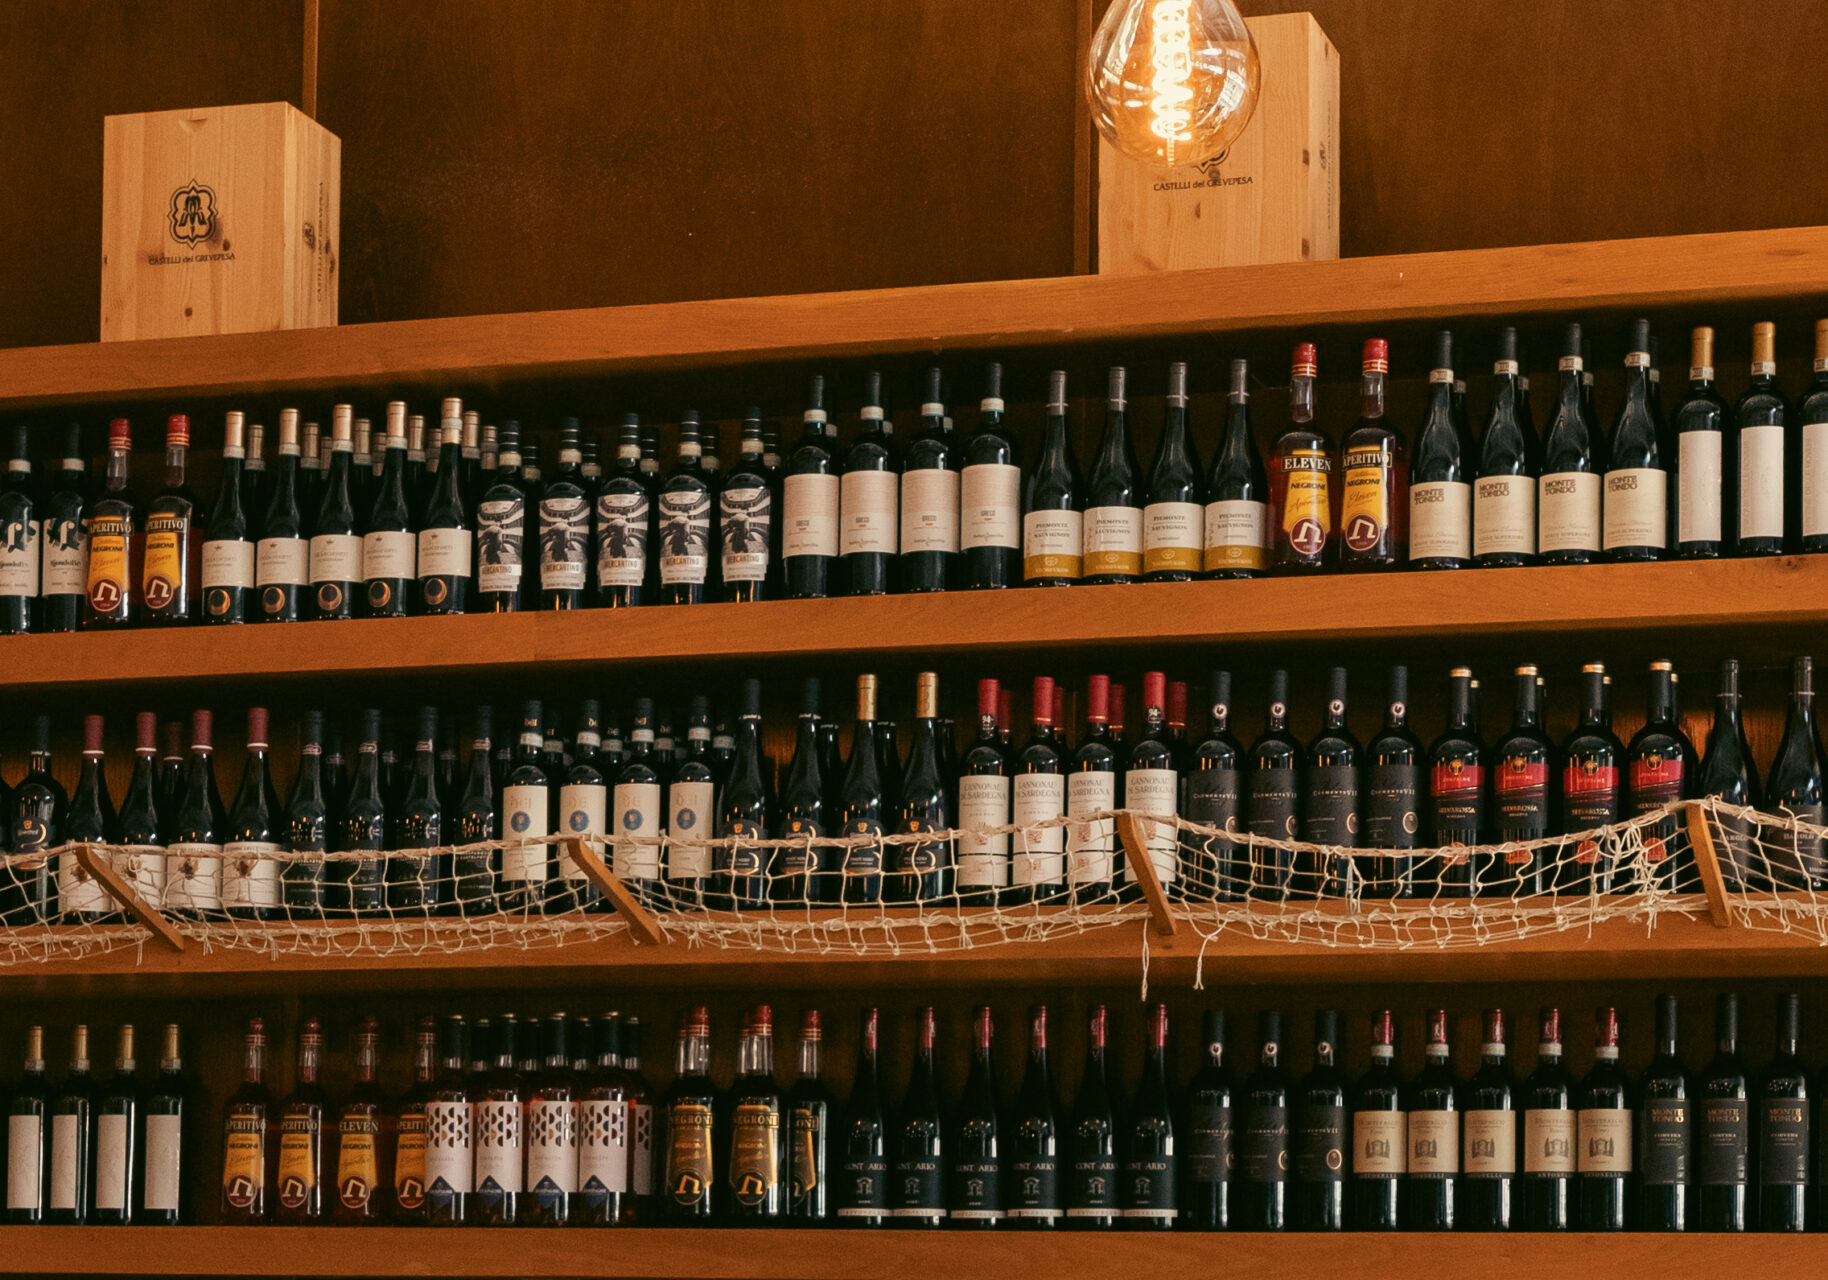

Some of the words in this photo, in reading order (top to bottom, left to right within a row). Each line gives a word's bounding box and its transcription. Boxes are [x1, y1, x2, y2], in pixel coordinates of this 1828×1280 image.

[1153, 182, 1190, 191] CASTELLI
[1206, 176, 1253, 187] GREVEPESA
[1284, 456, 1332, 472] ELEVEN
[1343, 452, 1390, 469] APERITIVO
[1347, 478, 1381, 487] NEGRONI
[1544, 479, 1576, 488] MONTE
[1607, 475, 1638, 485] MONTE
[1291, 481, 1326, 490] NEGRONI
[1479, 482, 1510, 491] MONTE
[1607, 483, 1638, 492] TONDO
[1414, 488, 1445, 497] MONTE
[1479, 490, 1510, 499] TONDO
[1544, 486, 1576, 496] TONDO
[1414, 495, 1445, 505] TONDO
[966, 791, 1008, 800] SARDEGNA
[1783, 832, 1815, 843] BAOLO
[670, 1114, 713, 1126] EGRONI
[732, 1114, 777, 1126] EGRONI
[339, 1121, 379, 1132] ELEVEN
[398, 1120, 426, 1131] APERITI
